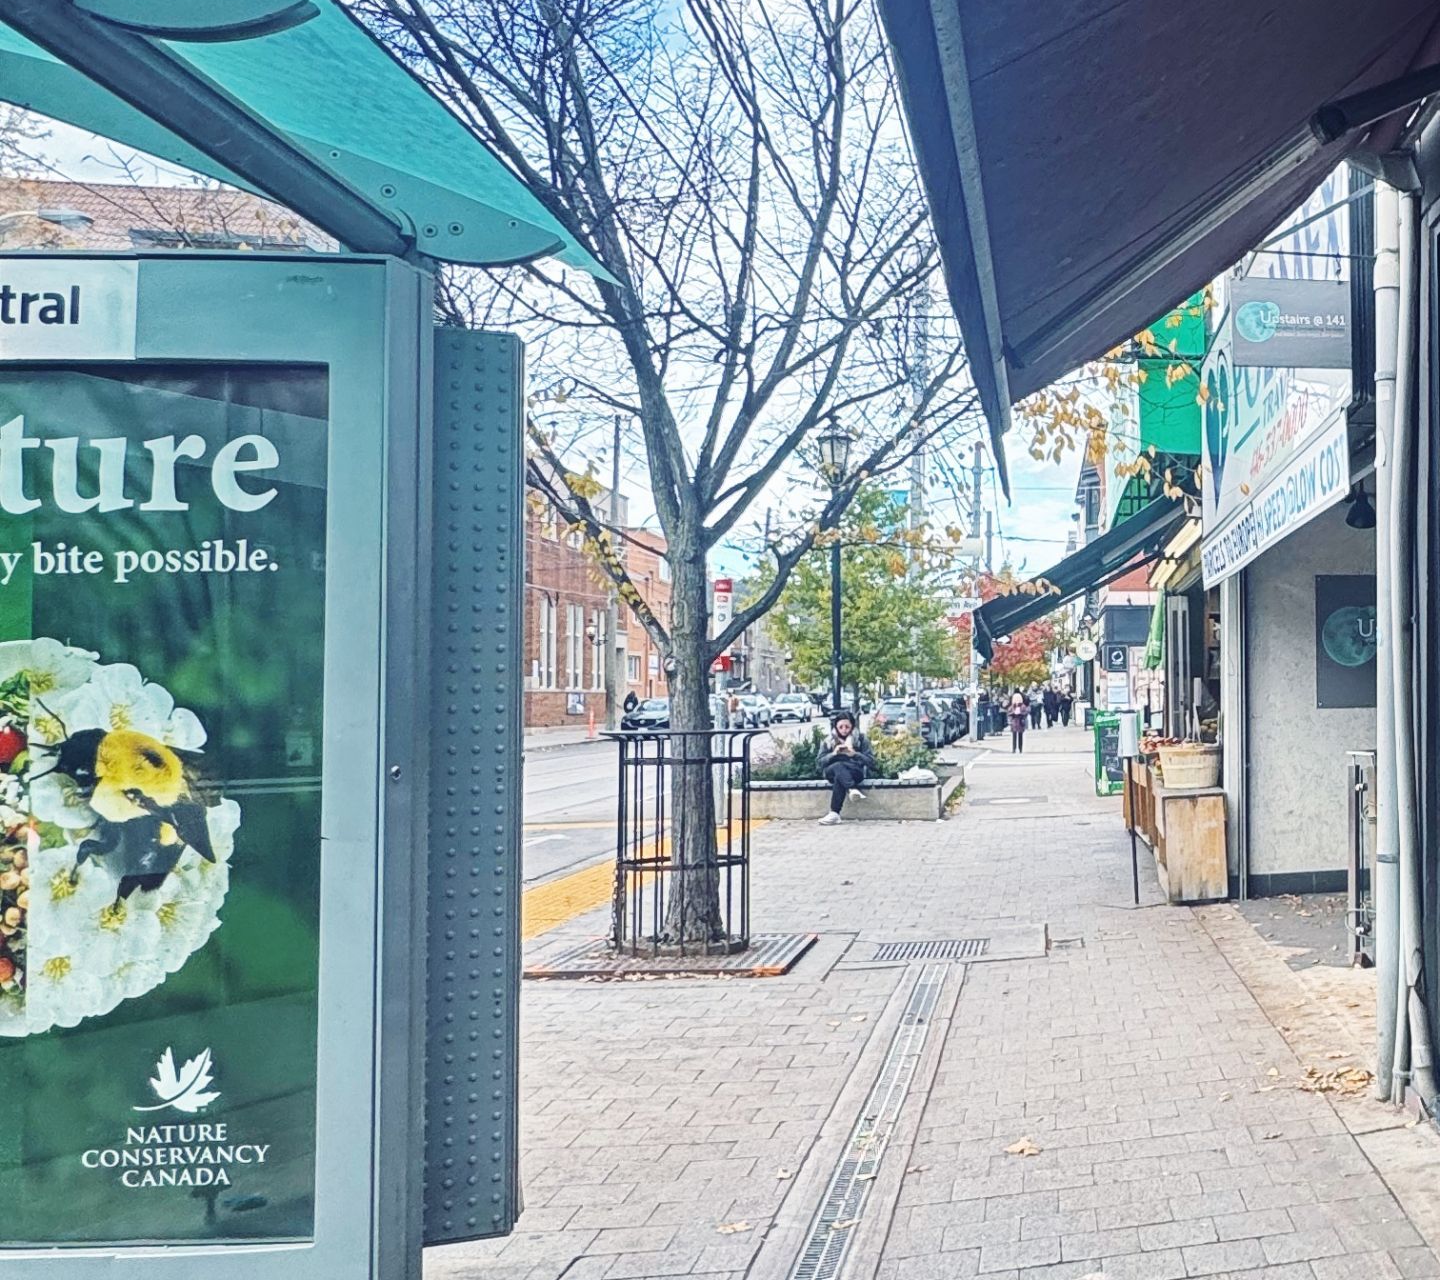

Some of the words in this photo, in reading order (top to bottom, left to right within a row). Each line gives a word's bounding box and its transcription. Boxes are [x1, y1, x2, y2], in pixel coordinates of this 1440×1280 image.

[1260, 310, 1310, 326] Upstairs
[1313, 315, 1324, 326] @
[1326, 314, 1346, 326] 141
[0, 414, 280, 515] ture
[32, 541, 104, 575] bite
[115, 539, 279, 583] possible.
[126, 1123, 227, 1145] NATURE
[81, 1144, 270, 1168] CONSERVANCY
[122, 1167, 230, 1187] CANADA
